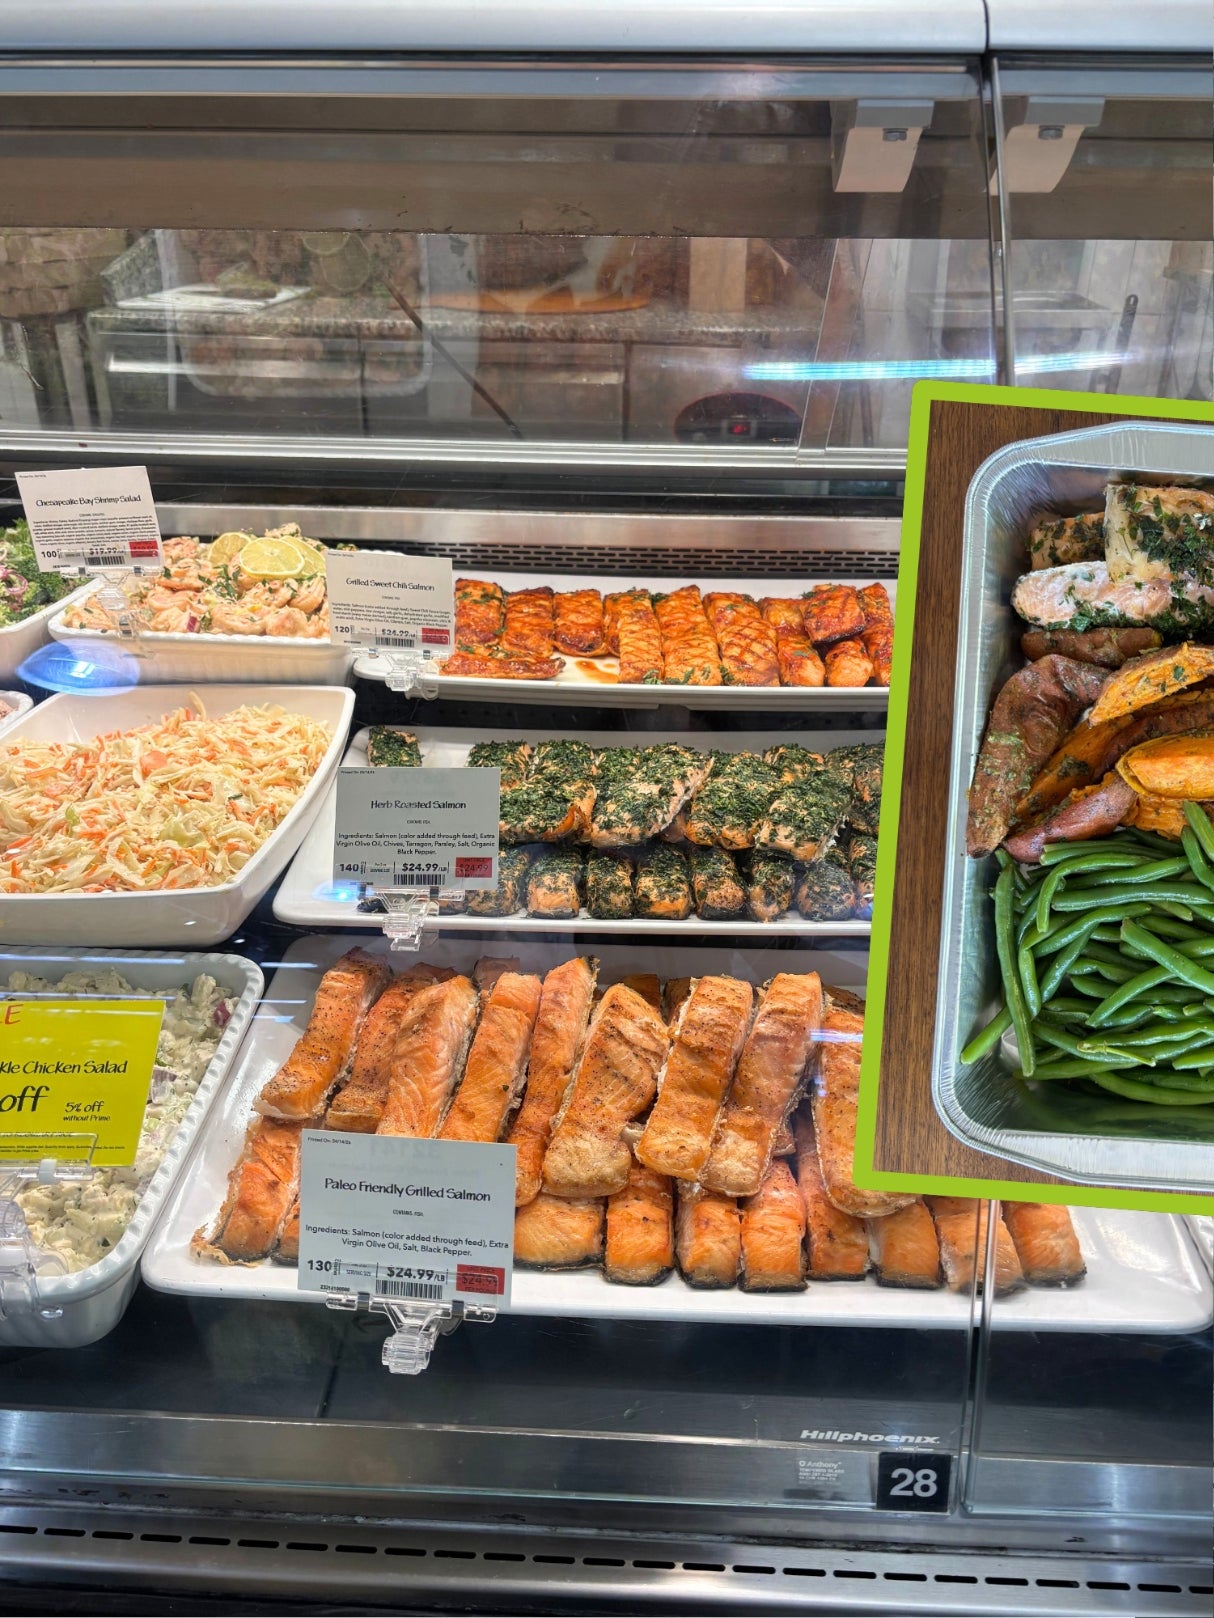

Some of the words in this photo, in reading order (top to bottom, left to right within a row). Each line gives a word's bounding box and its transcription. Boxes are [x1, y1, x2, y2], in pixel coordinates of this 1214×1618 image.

[79, 497, 94, 506] Bay
[120, 494, 141, 502] Salad
[41, 550, 57, 559] 100
[346, 577, 369, 587] Grilled
[370, 579, 392, 589] Sweet
[392, 581, 408, 590] Chili
[408, 582, 435, 591] Salmon
[335, 625, 350, 633] 120
[371, 800, 393, 809] Herb
[394, 800, 432, 809] Roasted
[433, 800, 467, 809] Salmon
[338, 832, 374, 840] Ingredients:
[375, 832, 398, 840] Salmon
[416, 832, 436, 840] added
[437, 833, 461, 841] through
[336, 841, 354, 849] Virgin
[406, 841, 433, 849] Tarragon,
[471, 841, 495, 849] Organic
[339, 863, 359, 872] 140
[401, 863, 448, 873] $24.99/LB
[23, 1060, 82, 1075] Chicken
[84, 1060, 129, 1074] Salad
[0, 1085, 50, 1113] off
[65, 1101, 82, 1113] 5%
[84, 1100, 105, 1113] off
[63, 1114, 89, 1122] without
[89, 1114, 111, 1122] Prime
[325, 1177, 357, 1191] Paleo
[359, 1181, 405, 1198] Friendly
[405, 1185, 444, 1198] Grilled
[446, 1188, 491, 1202] Salmon
[305, 1224, 349, 1236] Ingredients:
[352, 1228, 381, 1239] Salmon
[381, 1231, 404, 1241] (color
[405, 1233, 431, 1243] added
[432, 1235, 464, 1246] through
[464, 1238, 488, 1249] feed),
[489, 1240, 509, 1250] Extra
[341, 1237, 365, 1248] Virgin
[366, 1239, 386, 1249] Olive
[387, 1241, 401, 1251] Oil,
[402, 1243, 419, 1253] Salt,
[420, 1244, 442, 1254] Black
[442, 1246, 473, 1257] Pepper.
[307, 1259, 332, 1272] 130
[387, 1264, 446, 1283] $24.99/LB
[889, 1467, 938, 1498] 28
